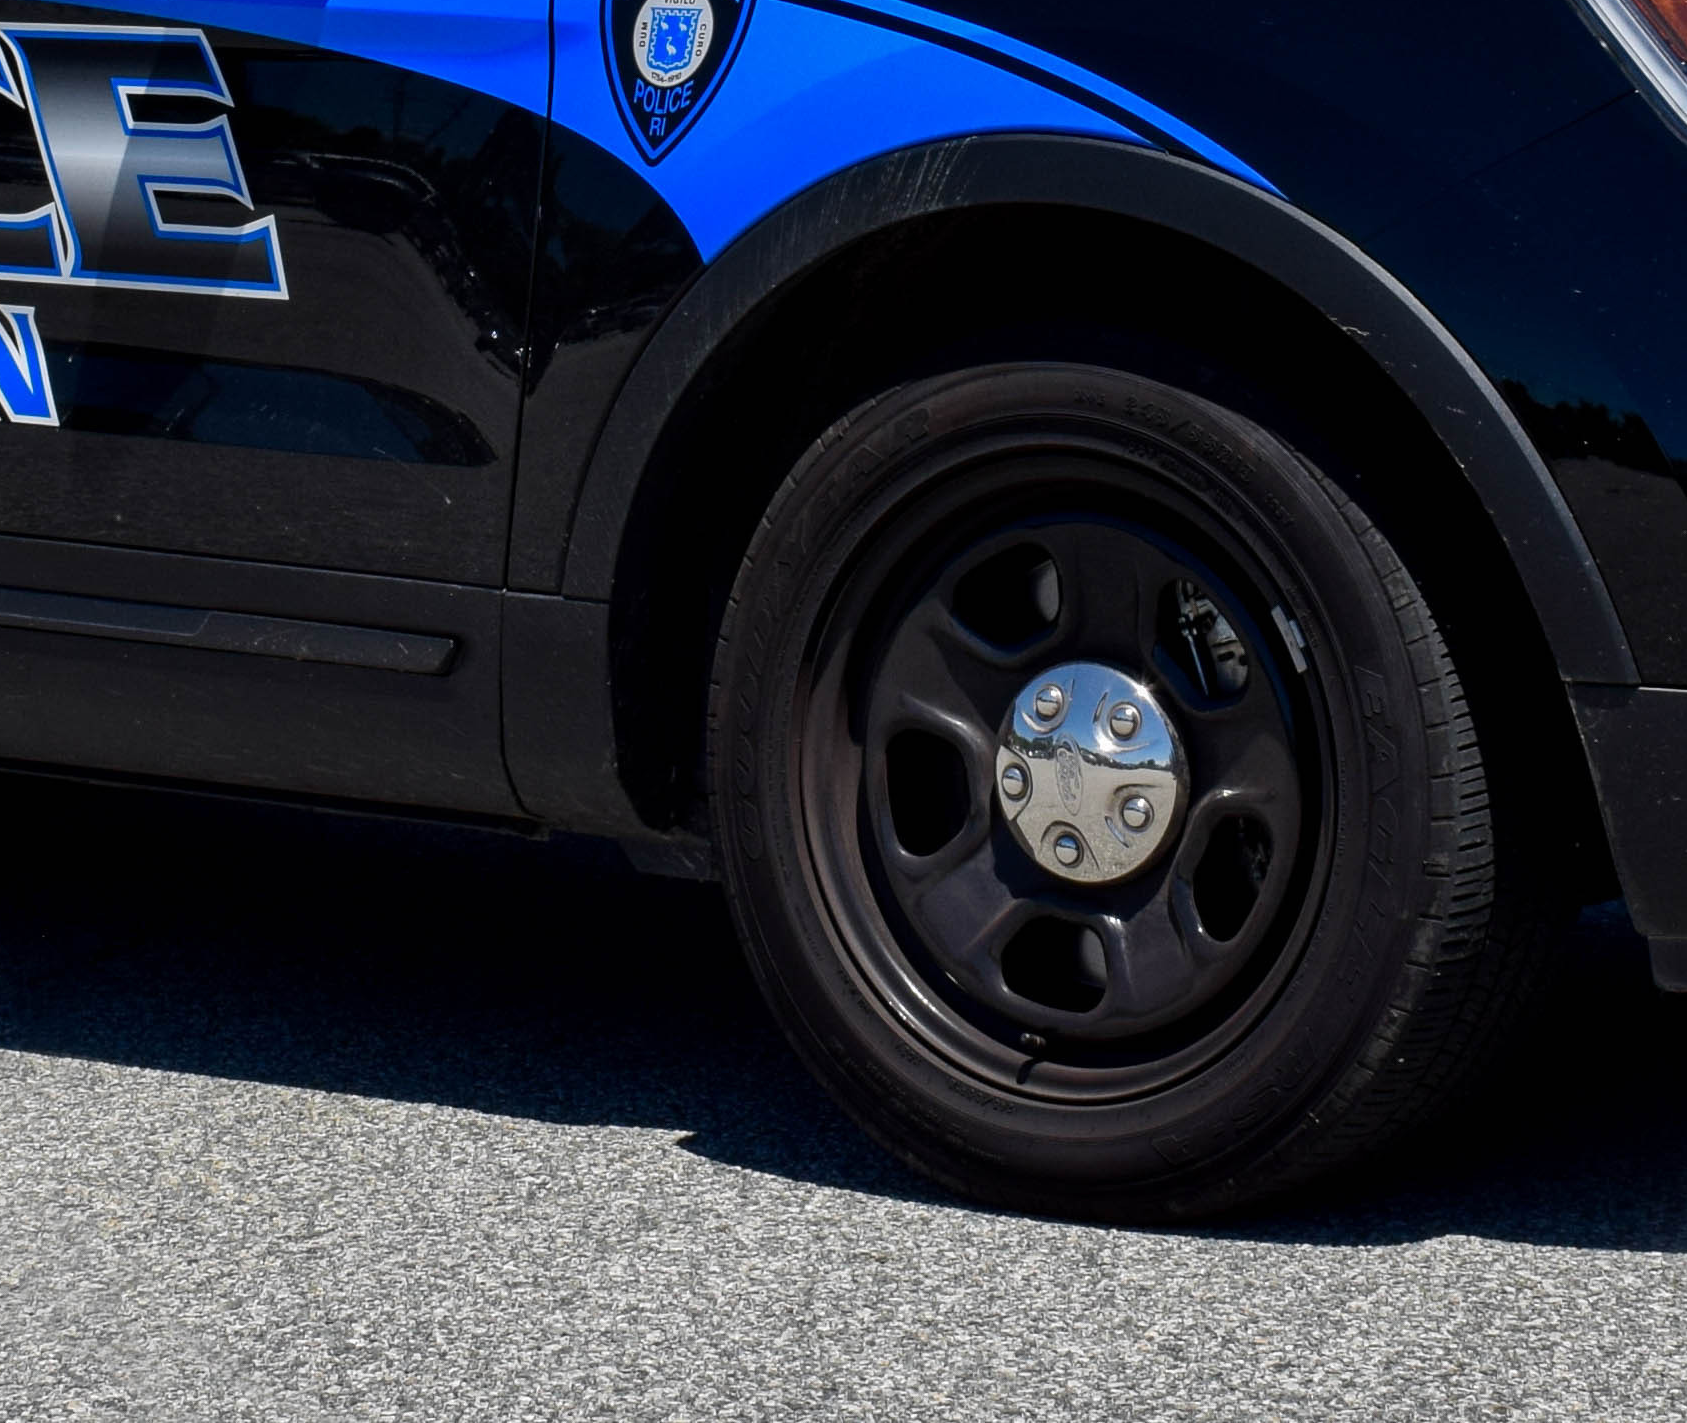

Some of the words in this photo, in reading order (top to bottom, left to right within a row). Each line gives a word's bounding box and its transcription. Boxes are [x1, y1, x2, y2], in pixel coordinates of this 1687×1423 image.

[639, 21, 649, 48] DUM
[695, 23, 707, 57] CURO
[634, 78, 695, 114] POLICE
[649, 117, 666, 136] RI
